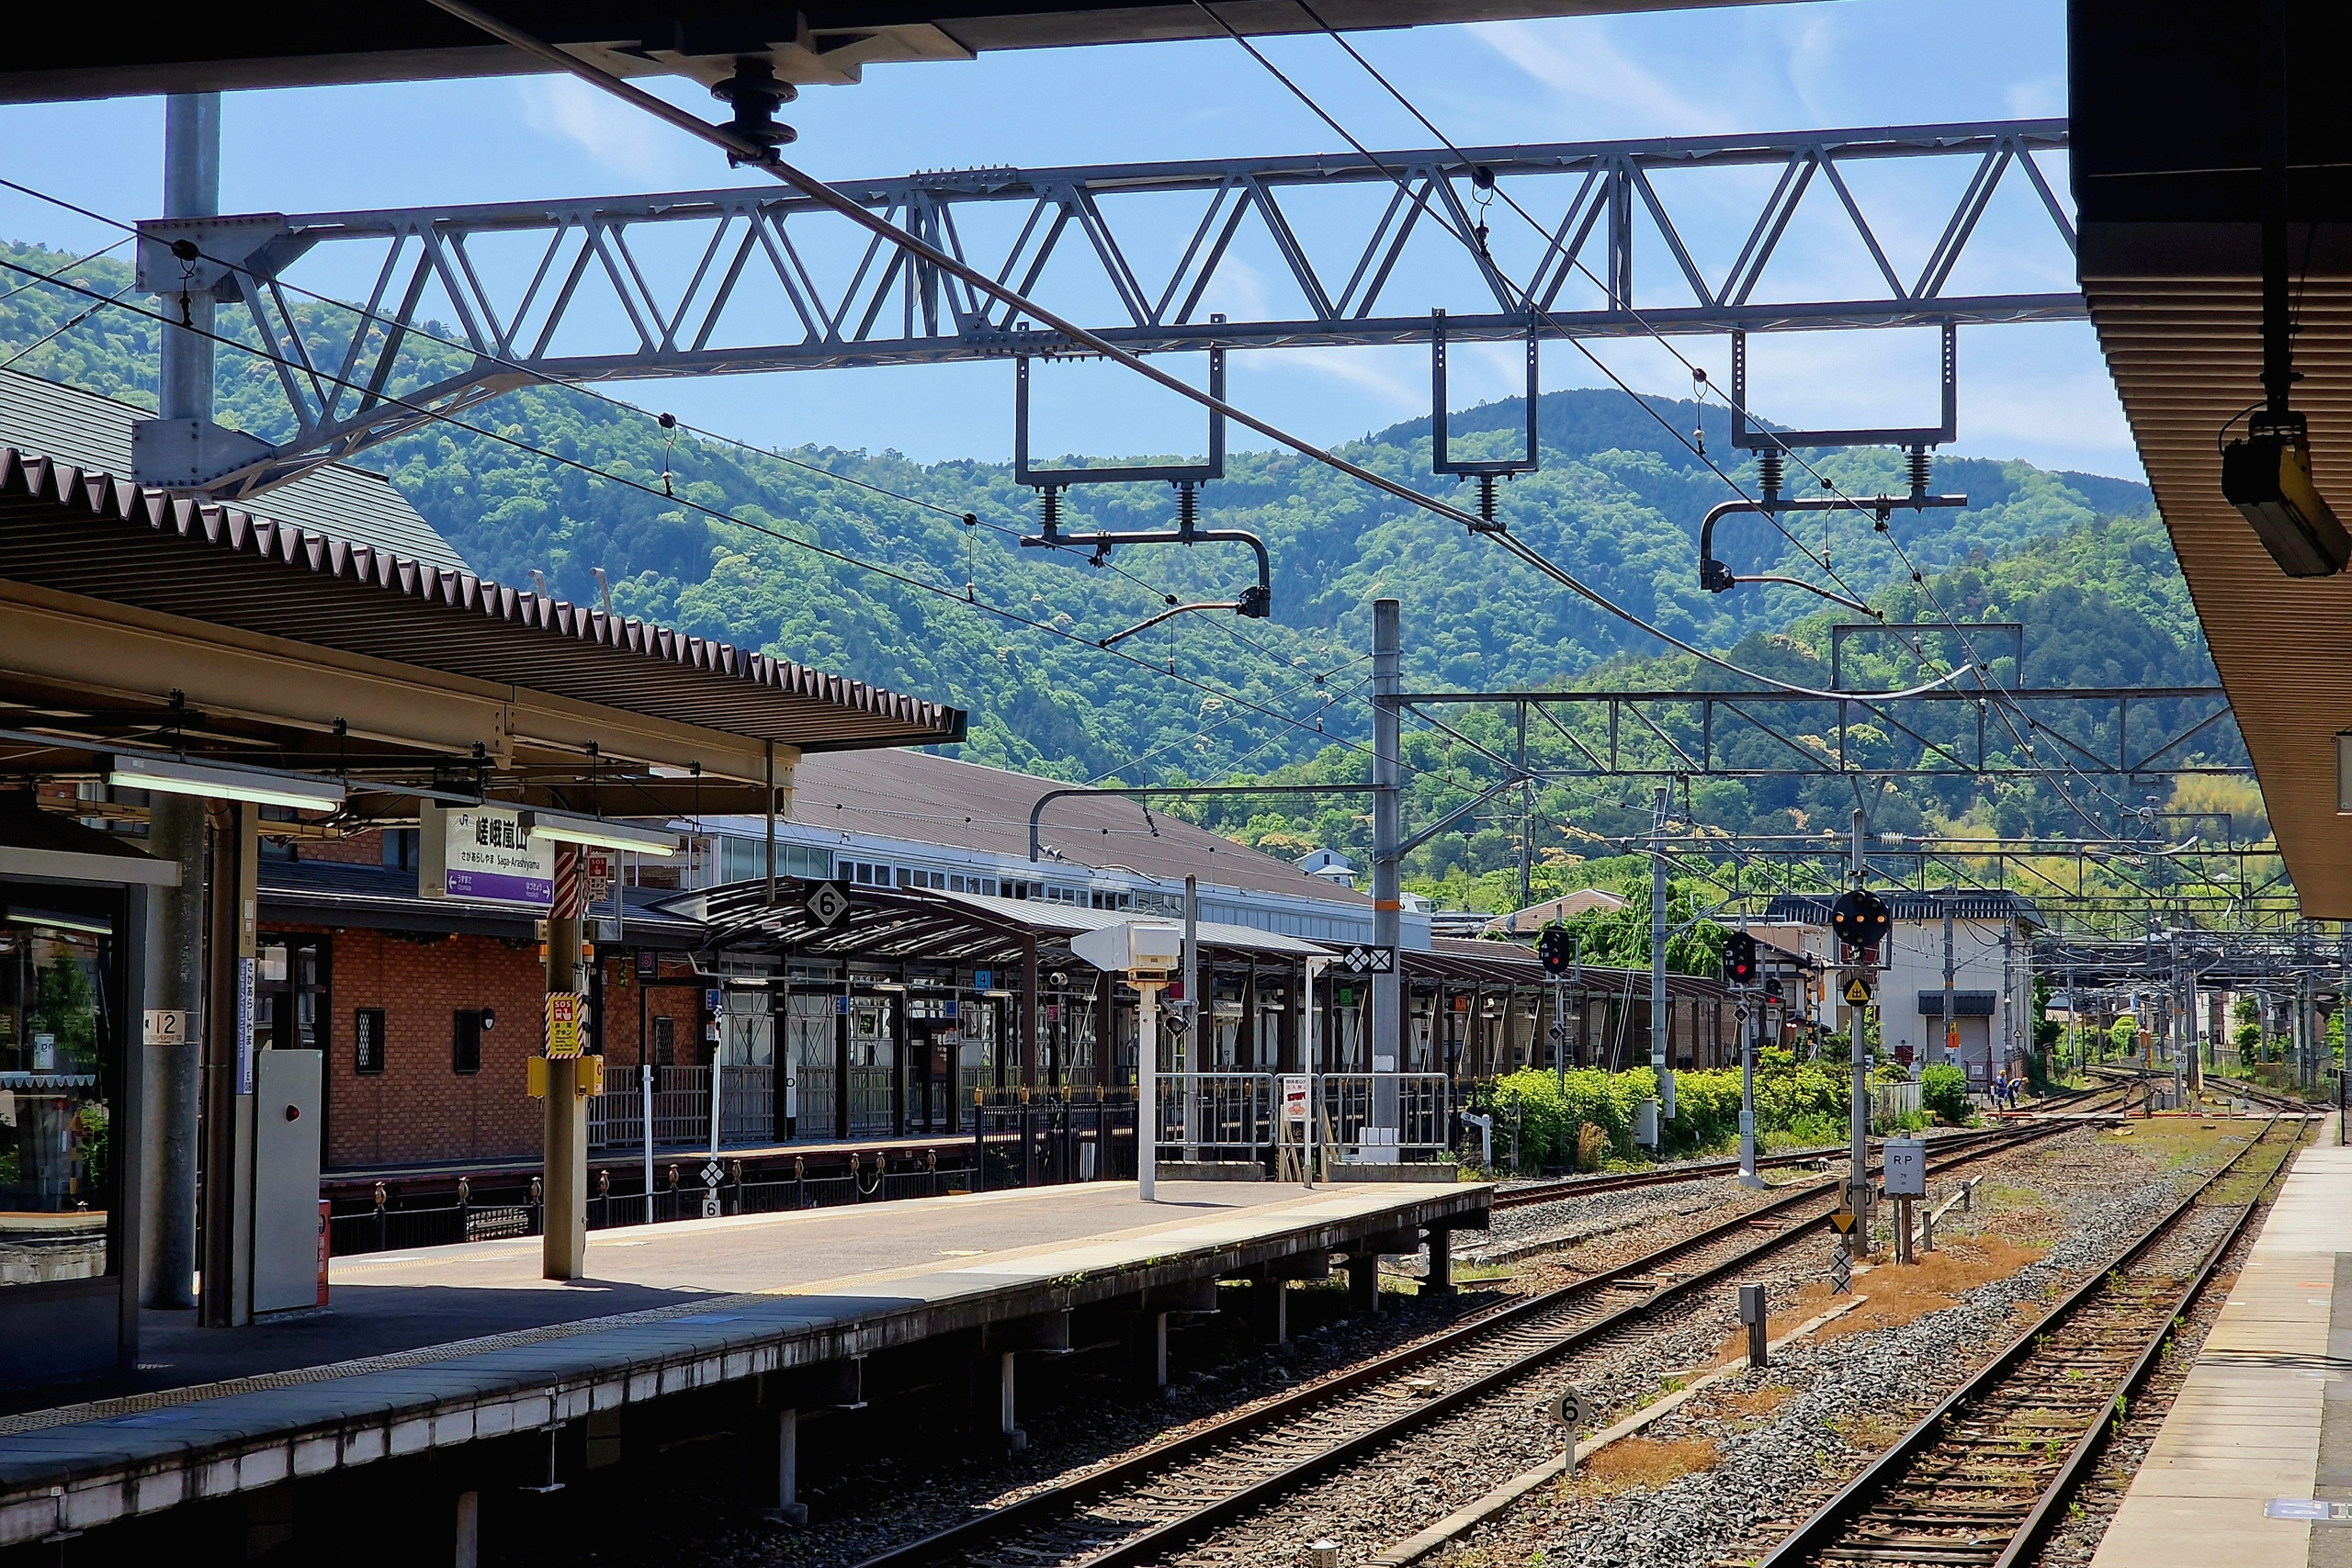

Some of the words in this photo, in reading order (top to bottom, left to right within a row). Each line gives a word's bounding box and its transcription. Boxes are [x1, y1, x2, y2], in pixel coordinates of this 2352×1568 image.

[459, 814, 469, 826] JR
[475, 816, 527, 852] 嵯峨嵐山
[461, 851, 494, 864] さがあらしやま
[497, 854, 540, 871] Saga-Arashiyama
[819, 891, 836, 917] 6
[641, 953, 652, 968] 5
[979, 973, 987, 985] 4
[1343, 990, 1350, 999] 2
[245, 962, 254, 1045] さがあらしやま
[156, 1014, 175, 1034] 12
[2175, 1055, 2187, 1065] 90
[707, 1201, 717, 1216] 6
[1562, 1396, 1579, 1422] 6
